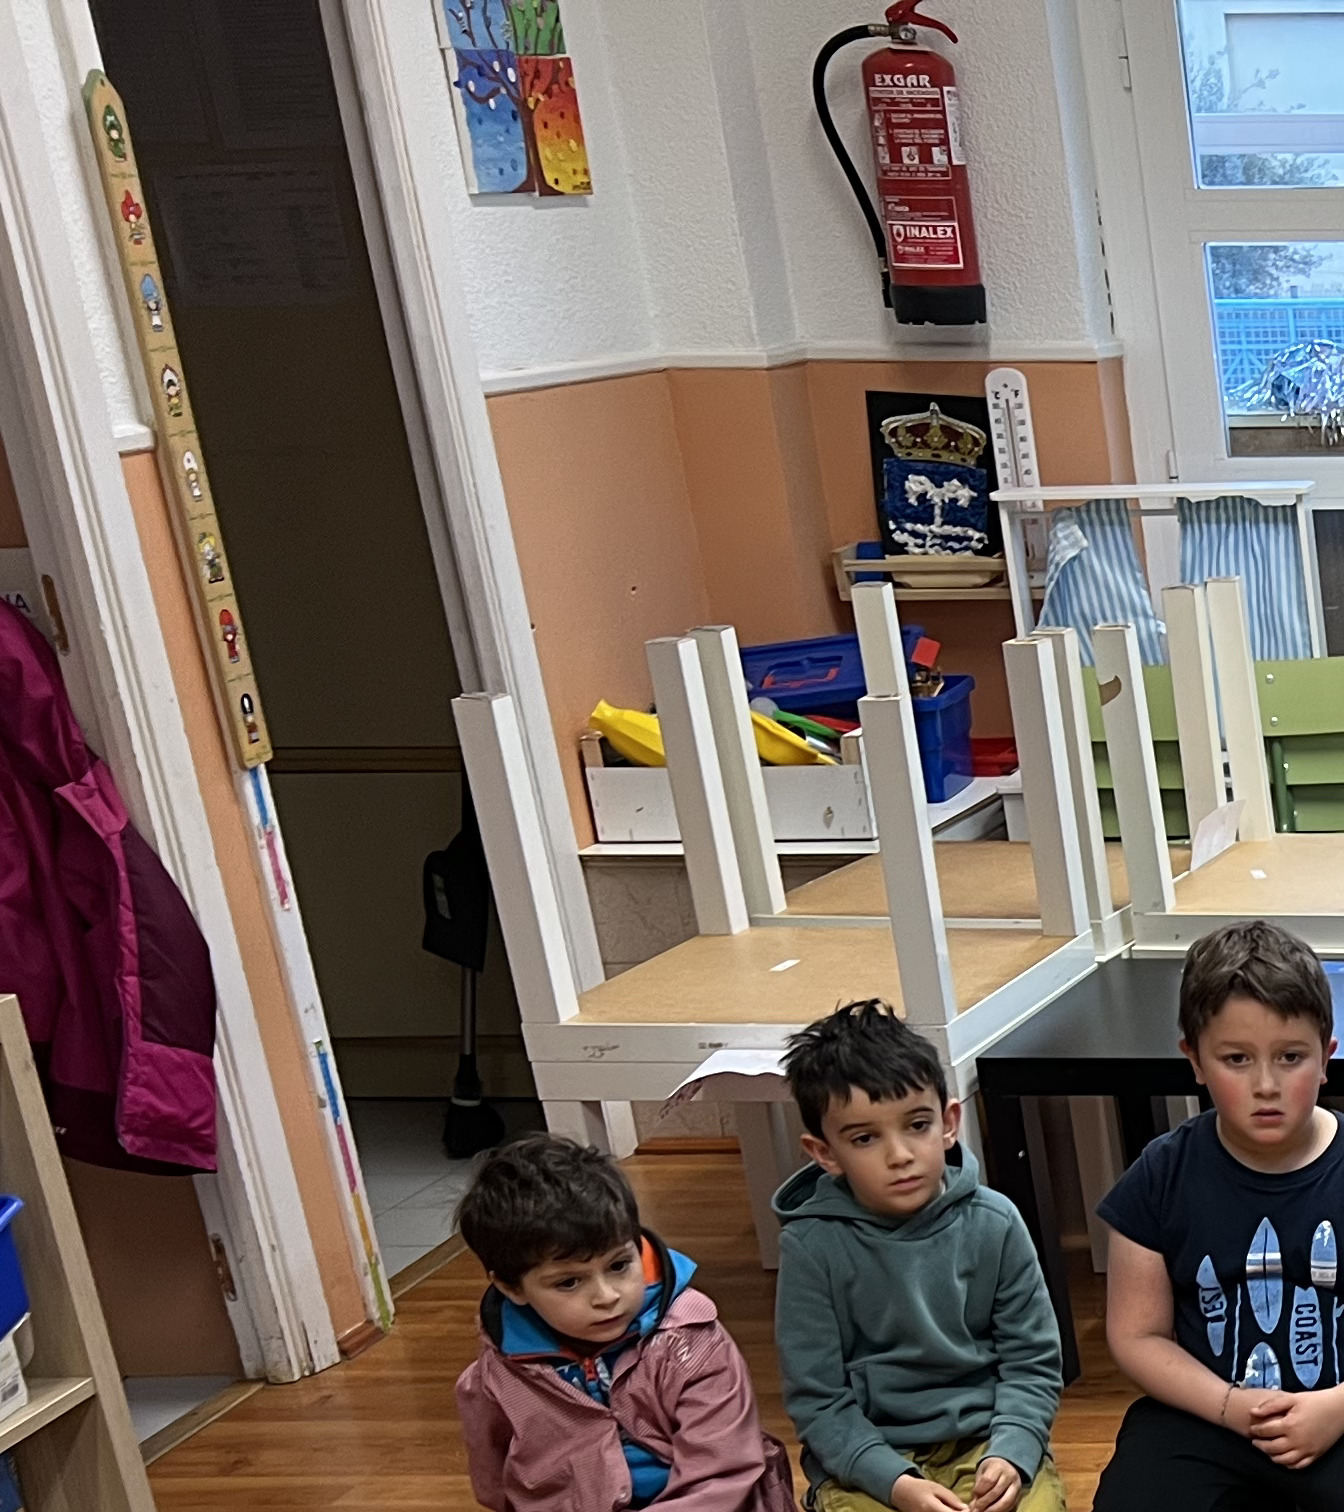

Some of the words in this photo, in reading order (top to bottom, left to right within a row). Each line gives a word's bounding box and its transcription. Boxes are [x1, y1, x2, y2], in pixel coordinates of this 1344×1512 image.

[874, 73, 931, 88] EXGAR
[906, 225, 954, 239] INALEX
[1294, 1302, 1319, 1368] COAST
